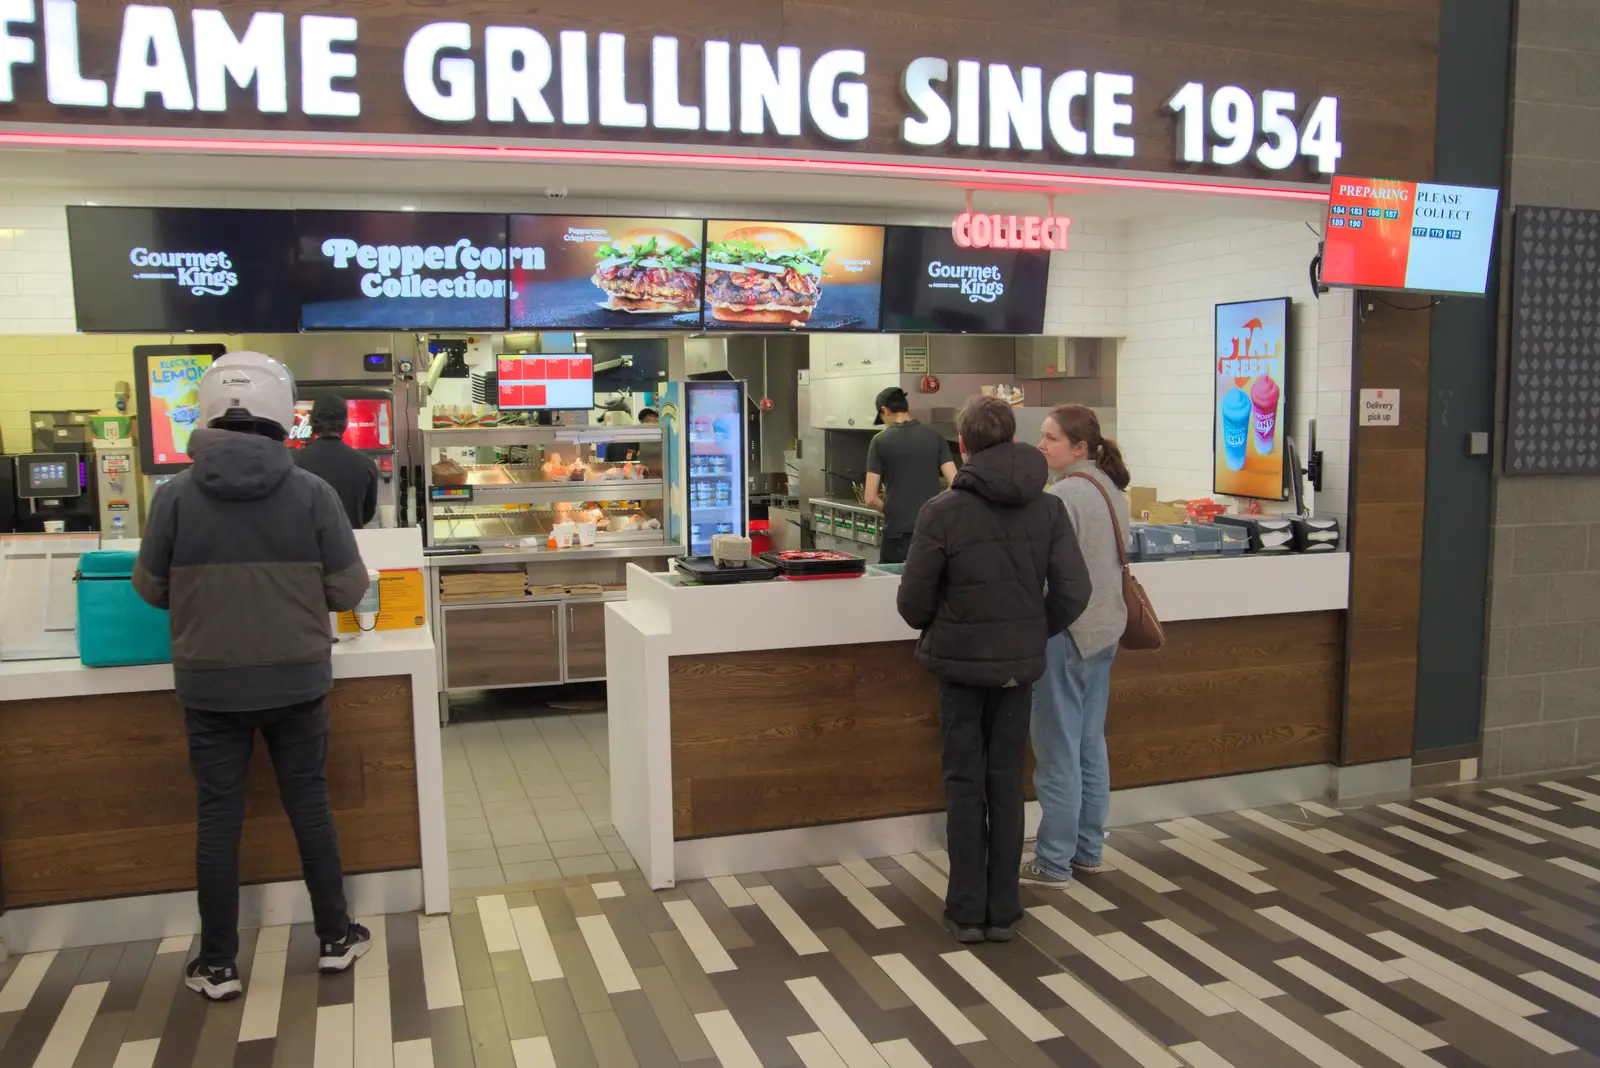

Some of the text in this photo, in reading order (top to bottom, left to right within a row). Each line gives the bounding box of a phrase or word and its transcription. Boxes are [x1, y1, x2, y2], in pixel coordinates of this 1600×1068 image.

[0, 0, 1342, 174] FLAME GRILLING SINCE 1954
[1339, 184, 1409, 201] PREPARING
[1417, 191, 1463, 205] PLEASE
[1332, 206, 1346, 214] 184
[1349, 207, 1363, 215] 183
[1384, 210, 1397, 218] 187
[1415, 206, 1472, 220] COLLECT
[953, 212, 1071, 250] COLLECT
[1331, 218, 1362, 227] 189 190
[1413, 228, 1460, 239] 177 179 182
[129, 247, 233, 272] Gourmet
[321, 238, 546, 277] Peppercorn
[928, 260, 1002, 283] Gourmet
[177, 266, 239, 296] Kings
[960, 278, 1004, 303] Kings
[1366, 401, 1394, 411] Delivery
[1367, 412, 1392, 422] pick up
